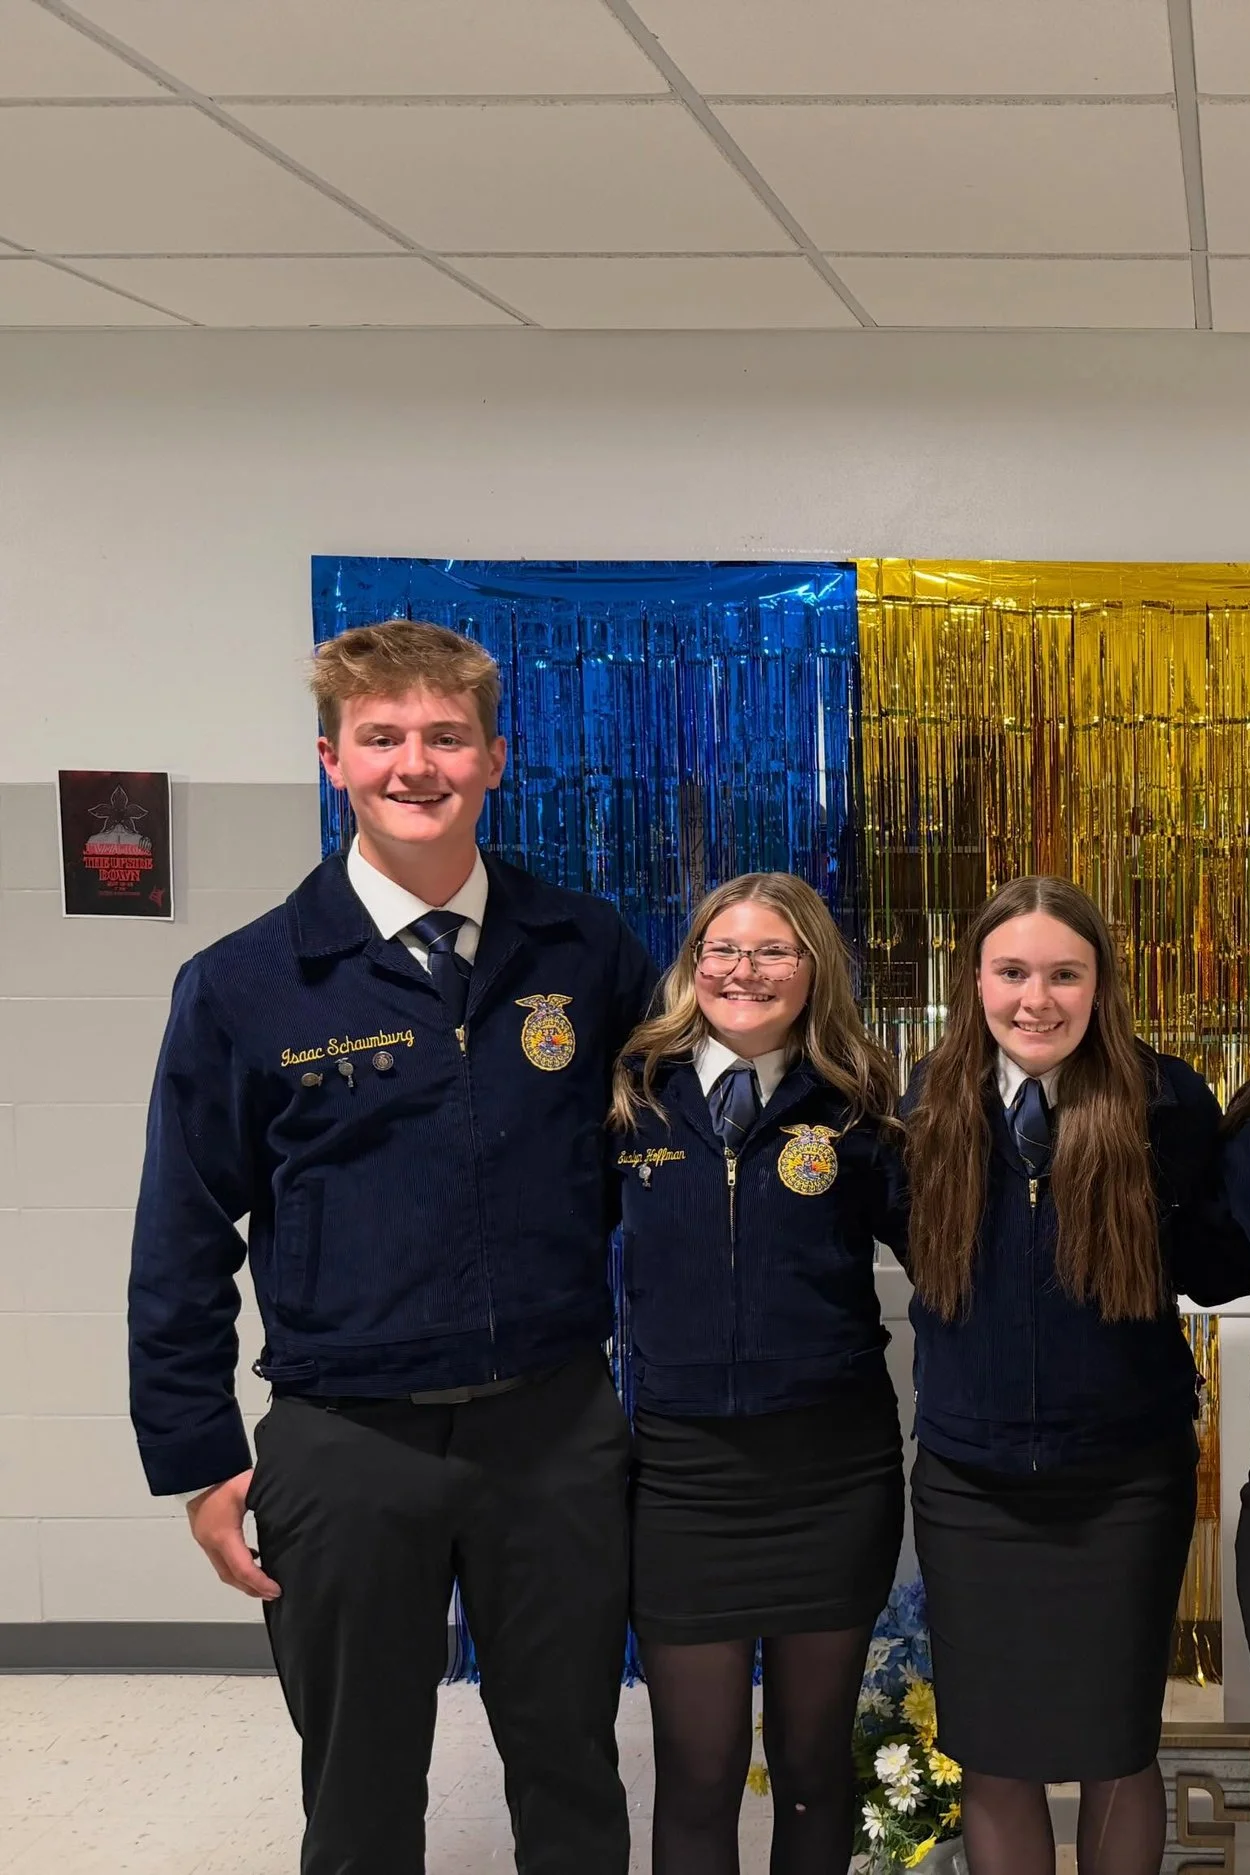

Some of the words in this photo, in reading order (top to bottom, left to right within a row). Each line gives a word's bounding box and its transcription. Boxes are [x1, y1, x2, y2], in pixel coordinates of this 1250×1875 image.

[99, 869, 140, 882] DOWN
[280, 1047, 326, 1067] Isaac
[326, 1029, 415, 1056] Schaumburg
[643, 1147, 686, 1167] Hoffman
